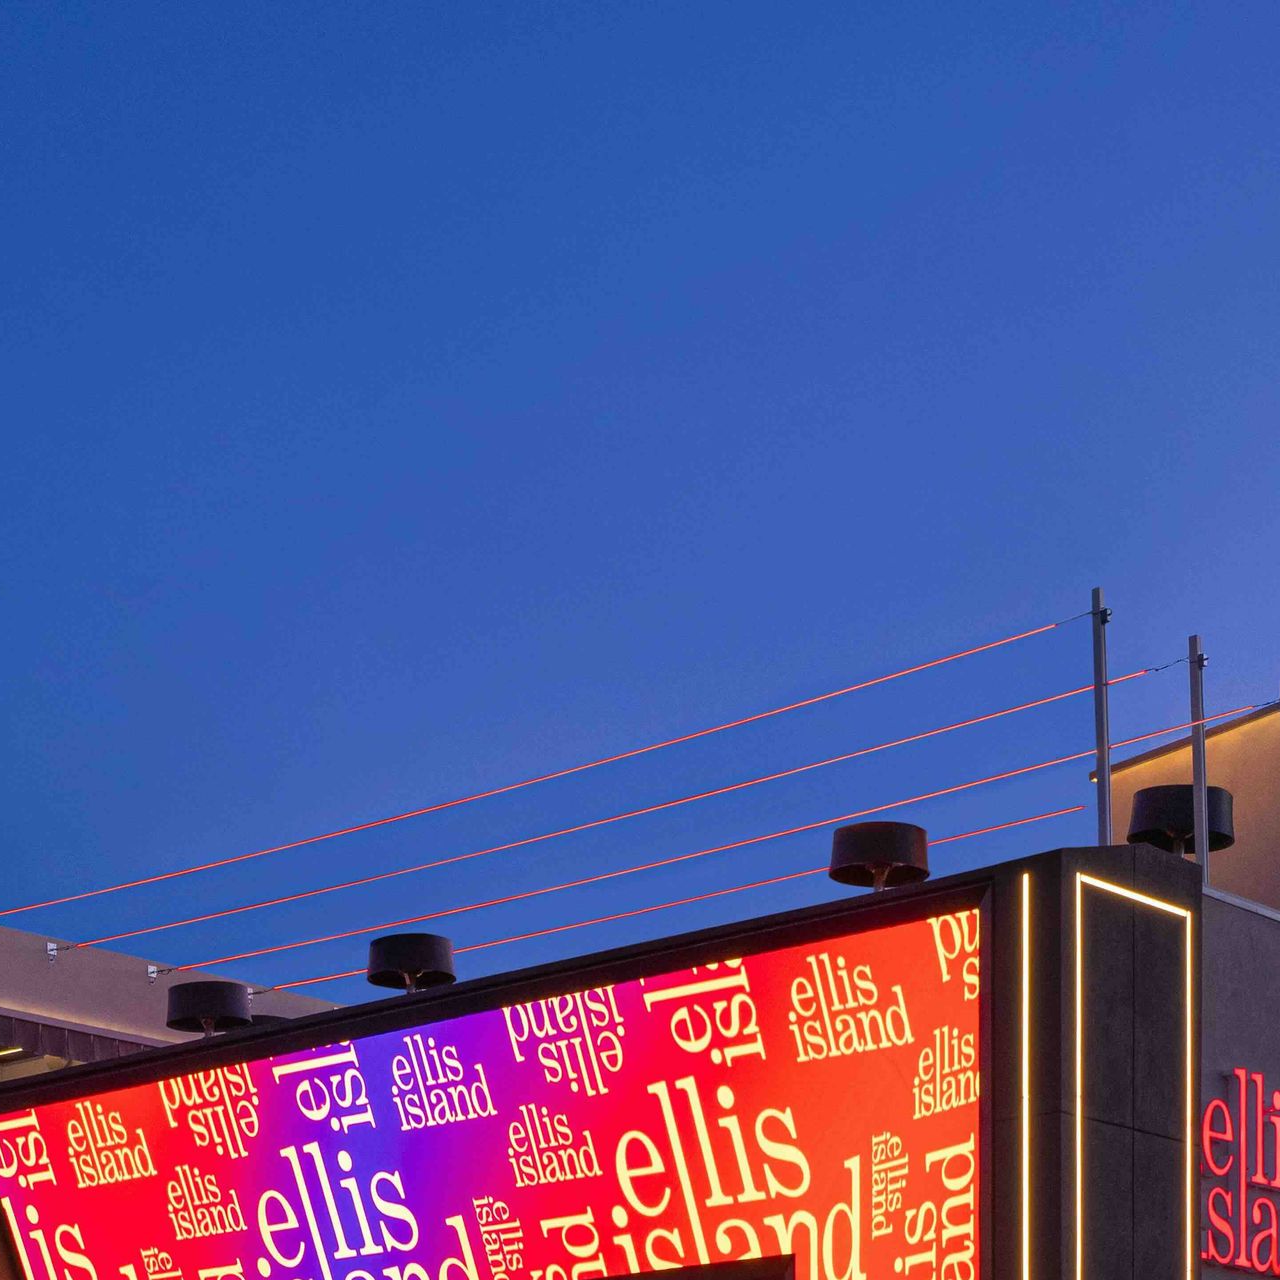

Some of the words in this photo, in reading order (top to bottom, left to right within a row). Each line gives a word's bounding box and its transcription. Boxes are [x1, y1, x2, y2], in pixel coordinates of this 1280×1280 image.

[791, 952, 878, 1018] ellis
[788, 985, 914, 1063] island
[919, 1025, 976, 1082] ellis
[392, 1034, 464, 1091] ellis
[537, 1031, 624, 1097] ellis
[392, 1064, 497, 1131] island
[912, 1070, 980, 1120] islan
[67, 1101, 127, 1151] ellis
[188, 1100, 260, 1160] ellis
[508, 1103, 573, 1154] ellis
[616, 1075, 812, 1217] ellis
[68, 1128, 157, 1189] island
[167, 1165, 221, 1210] ellis
[508, 1130, 603, 1188] island
[872, 1132, 893, 1240] island
[886, 1134, 909, 1213] ellis
[168, 1189, 247, 1240] island
[257, 1141, 419, 1268] ellis
[492, 1200, 524, 1271] ellis
